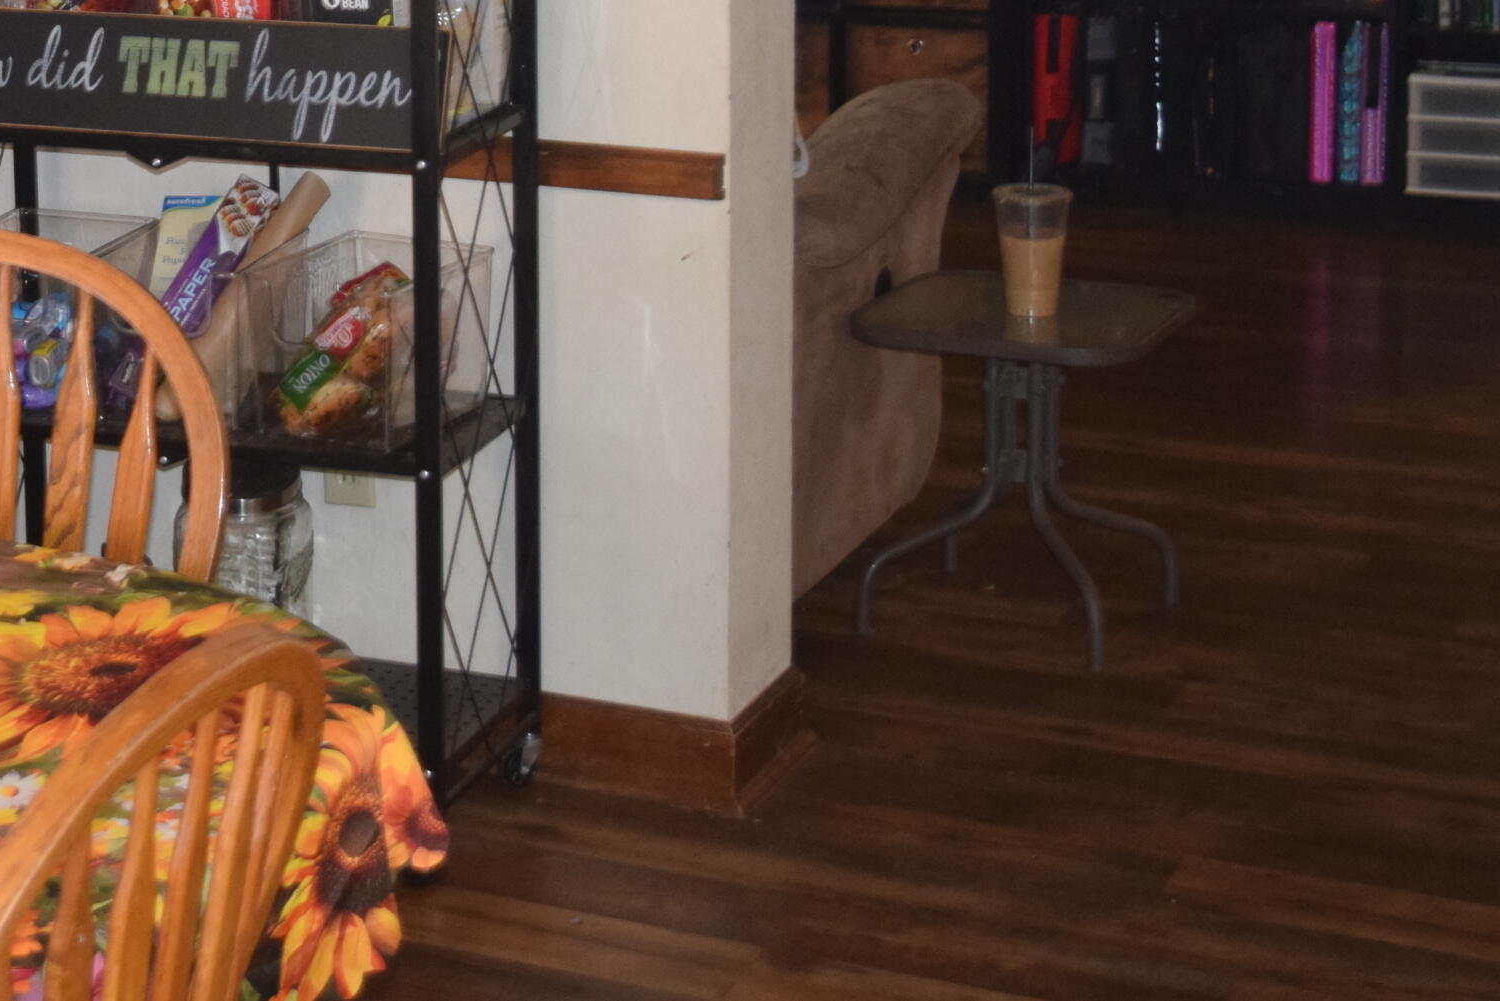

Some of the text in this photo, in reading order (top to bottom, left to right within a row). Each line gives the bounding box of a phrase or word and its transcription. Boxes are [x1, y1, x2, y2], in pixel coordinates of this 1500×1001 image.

[25, 24, 105, 93] did
[118, 36, 241, 98] THAT
[245, 28, 414, 144] happen
[170, 258, 217, 321] PAPER
[291, 353, 331, 394] ONION
